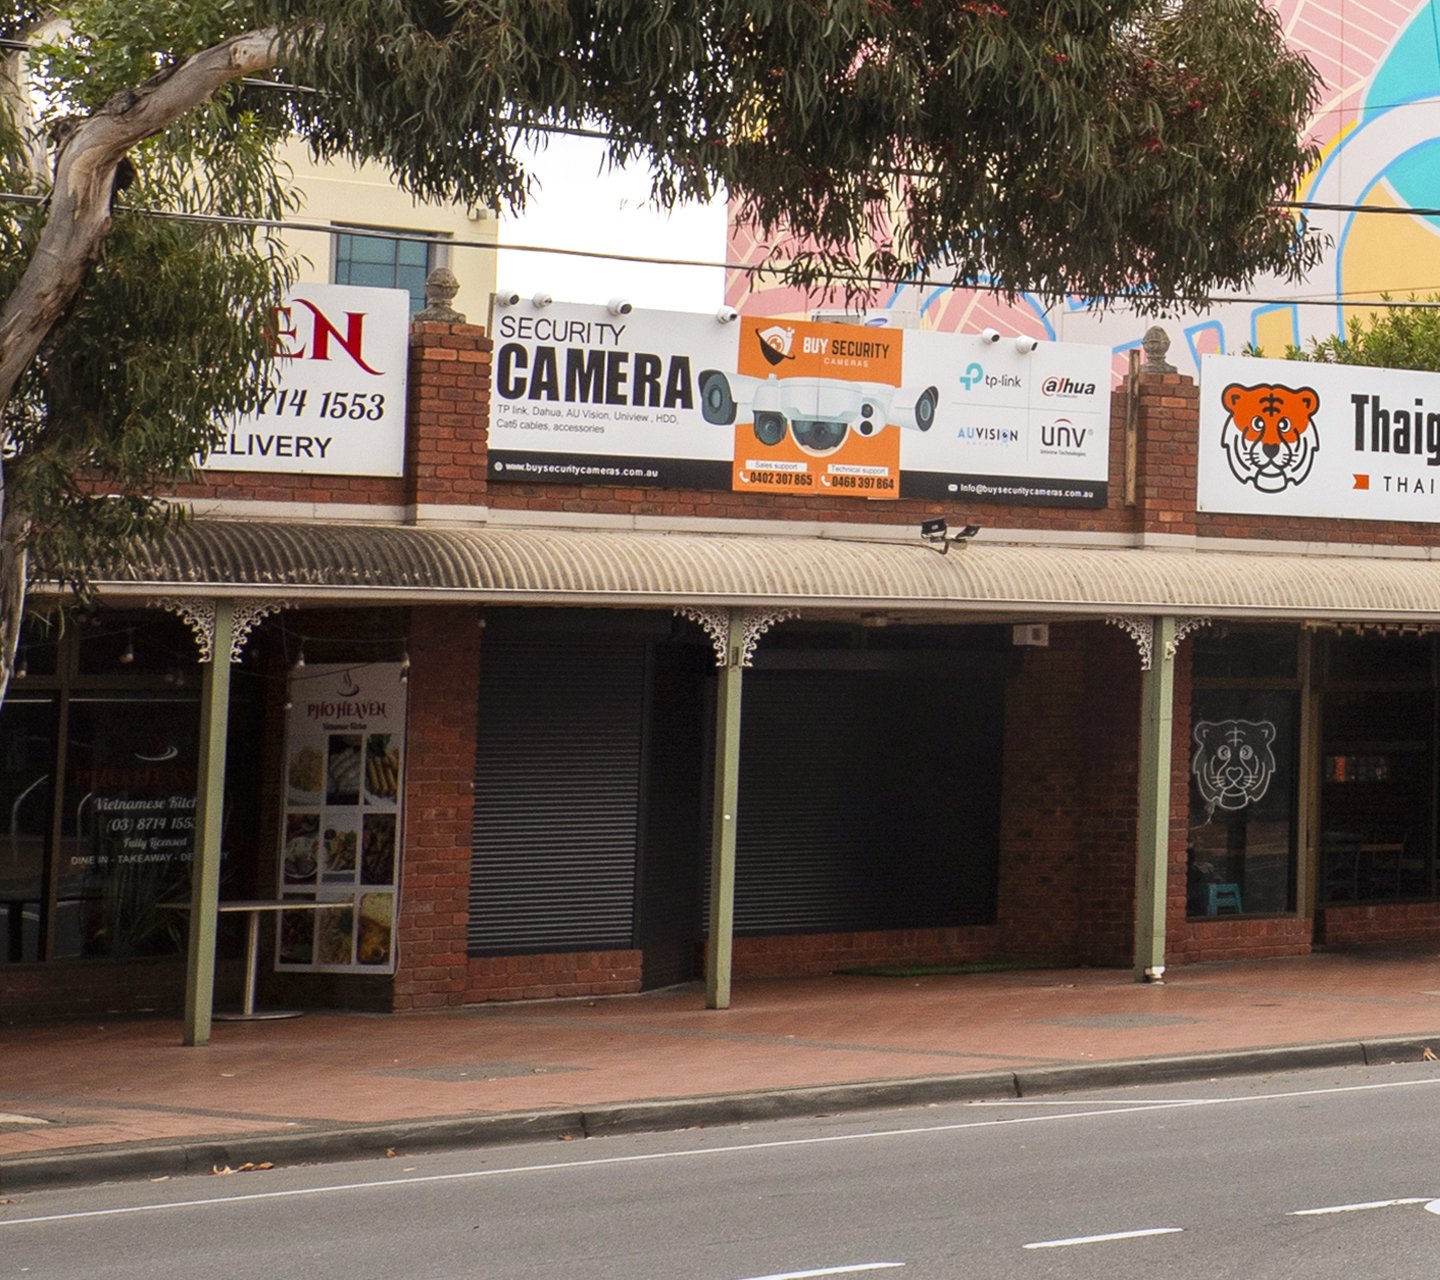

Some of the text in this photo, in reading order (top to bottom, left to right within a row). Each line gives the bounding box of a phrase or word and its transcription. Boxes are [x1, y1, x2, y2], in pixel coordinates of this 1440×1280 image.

[500, 315, 627, 346] SECURITY
[803, 337, 890, 359] BUY SECURITY
[824, 357, 869, 368] CAMERAS
[497, 342, 694, 410] CAMERA
[985, 373, 1022, 388] tp-link
[319, 391, 386, 421] 1553
[498, 404, 511, 415] TP
[512, 405, 530, 417] link,
[532, 406, 564, 419] Dahua,
[566, 408, 580, 419] AU
[582, 410, 612, 423] Vision,
[656, 414, 680, 425] HDD,
[496, 419, 605, 434] Cat6 cables, accessories
[196, 433, 333, 458] ELIVERY
[505, 462, 659, 478] www.buysecuritycameras.com.au
[774, 462, 798, 472] support
[832, 465, 886, 476] Technical support
[750, 472, 813, 486] 0402 307 865
[832, 476, 894, 490] 0468 397 864
[1384, 476, 1434, 495] THAI
[307, 701, 387, 719] PHO HEAVEN
[95, 798, 165, 810] Vietnamese
[106, 818, 134, 833] (03)
[137, 818, 167, 830] 8714
[124, 838, 147, 849] Fully
[71, 856, 95, 865] DINE
[98, 856, 108, 864] IN
[118, 853, 172, 863] TAKEAWAY
